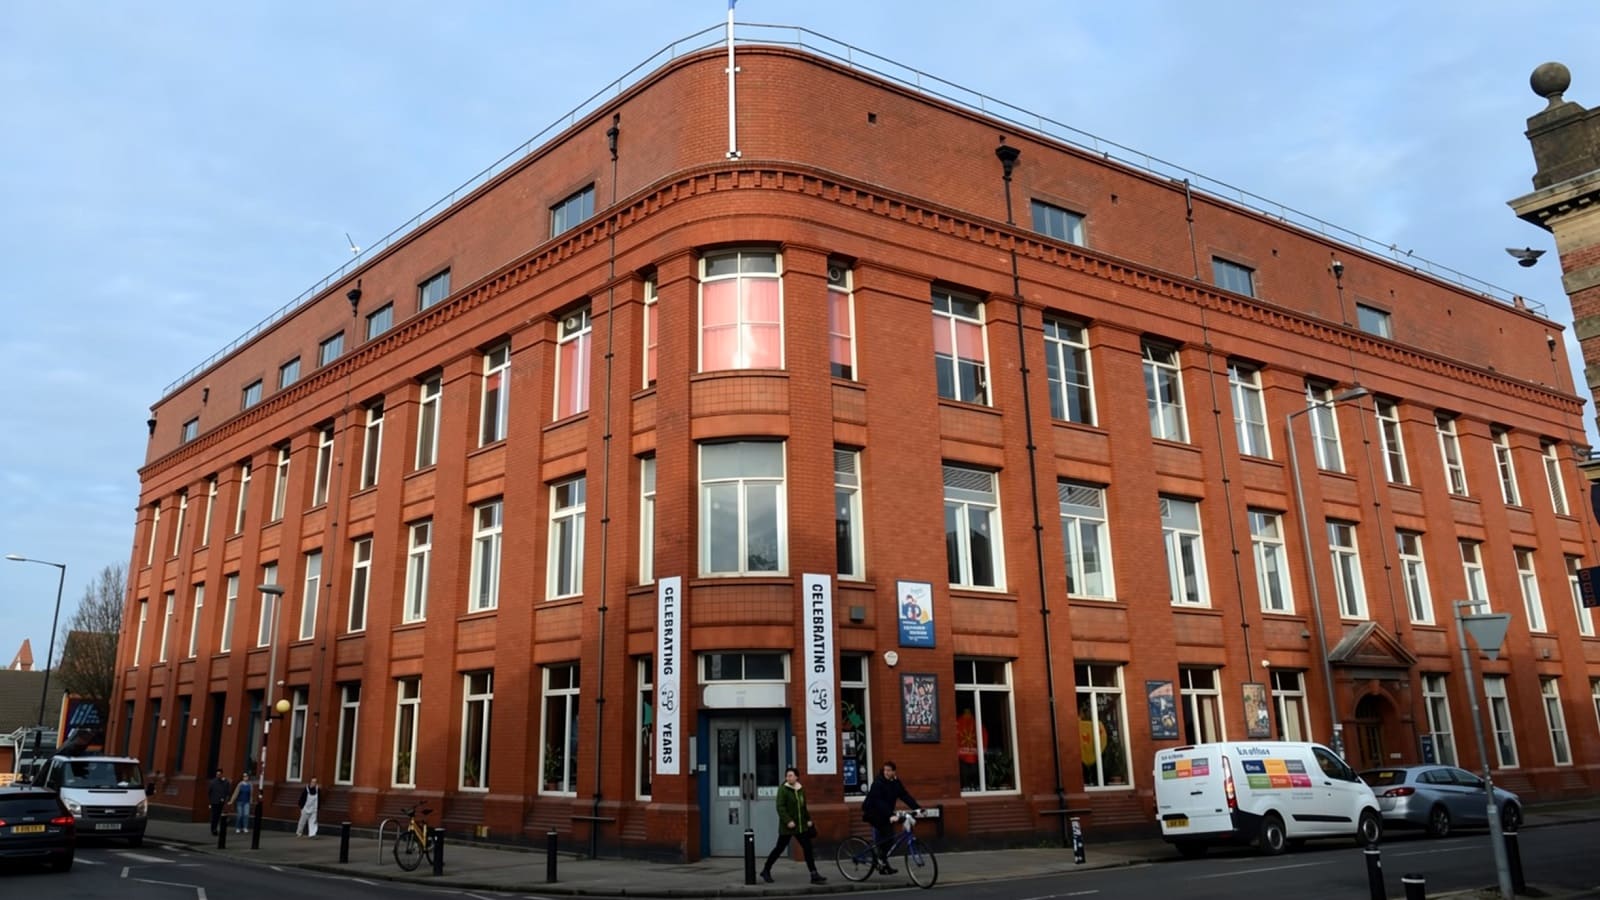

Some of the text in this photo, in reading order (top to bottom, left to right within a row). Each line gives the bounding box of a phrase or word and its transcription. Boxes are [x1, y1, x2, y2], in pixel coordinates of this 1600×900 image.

[663, 586, 674, 676] CELEBRATING
[812, 583, 826, 674] CELEBRATING
[662, 722, 673, 764] YEARS
[815, 721, 829, 764] YEARS
